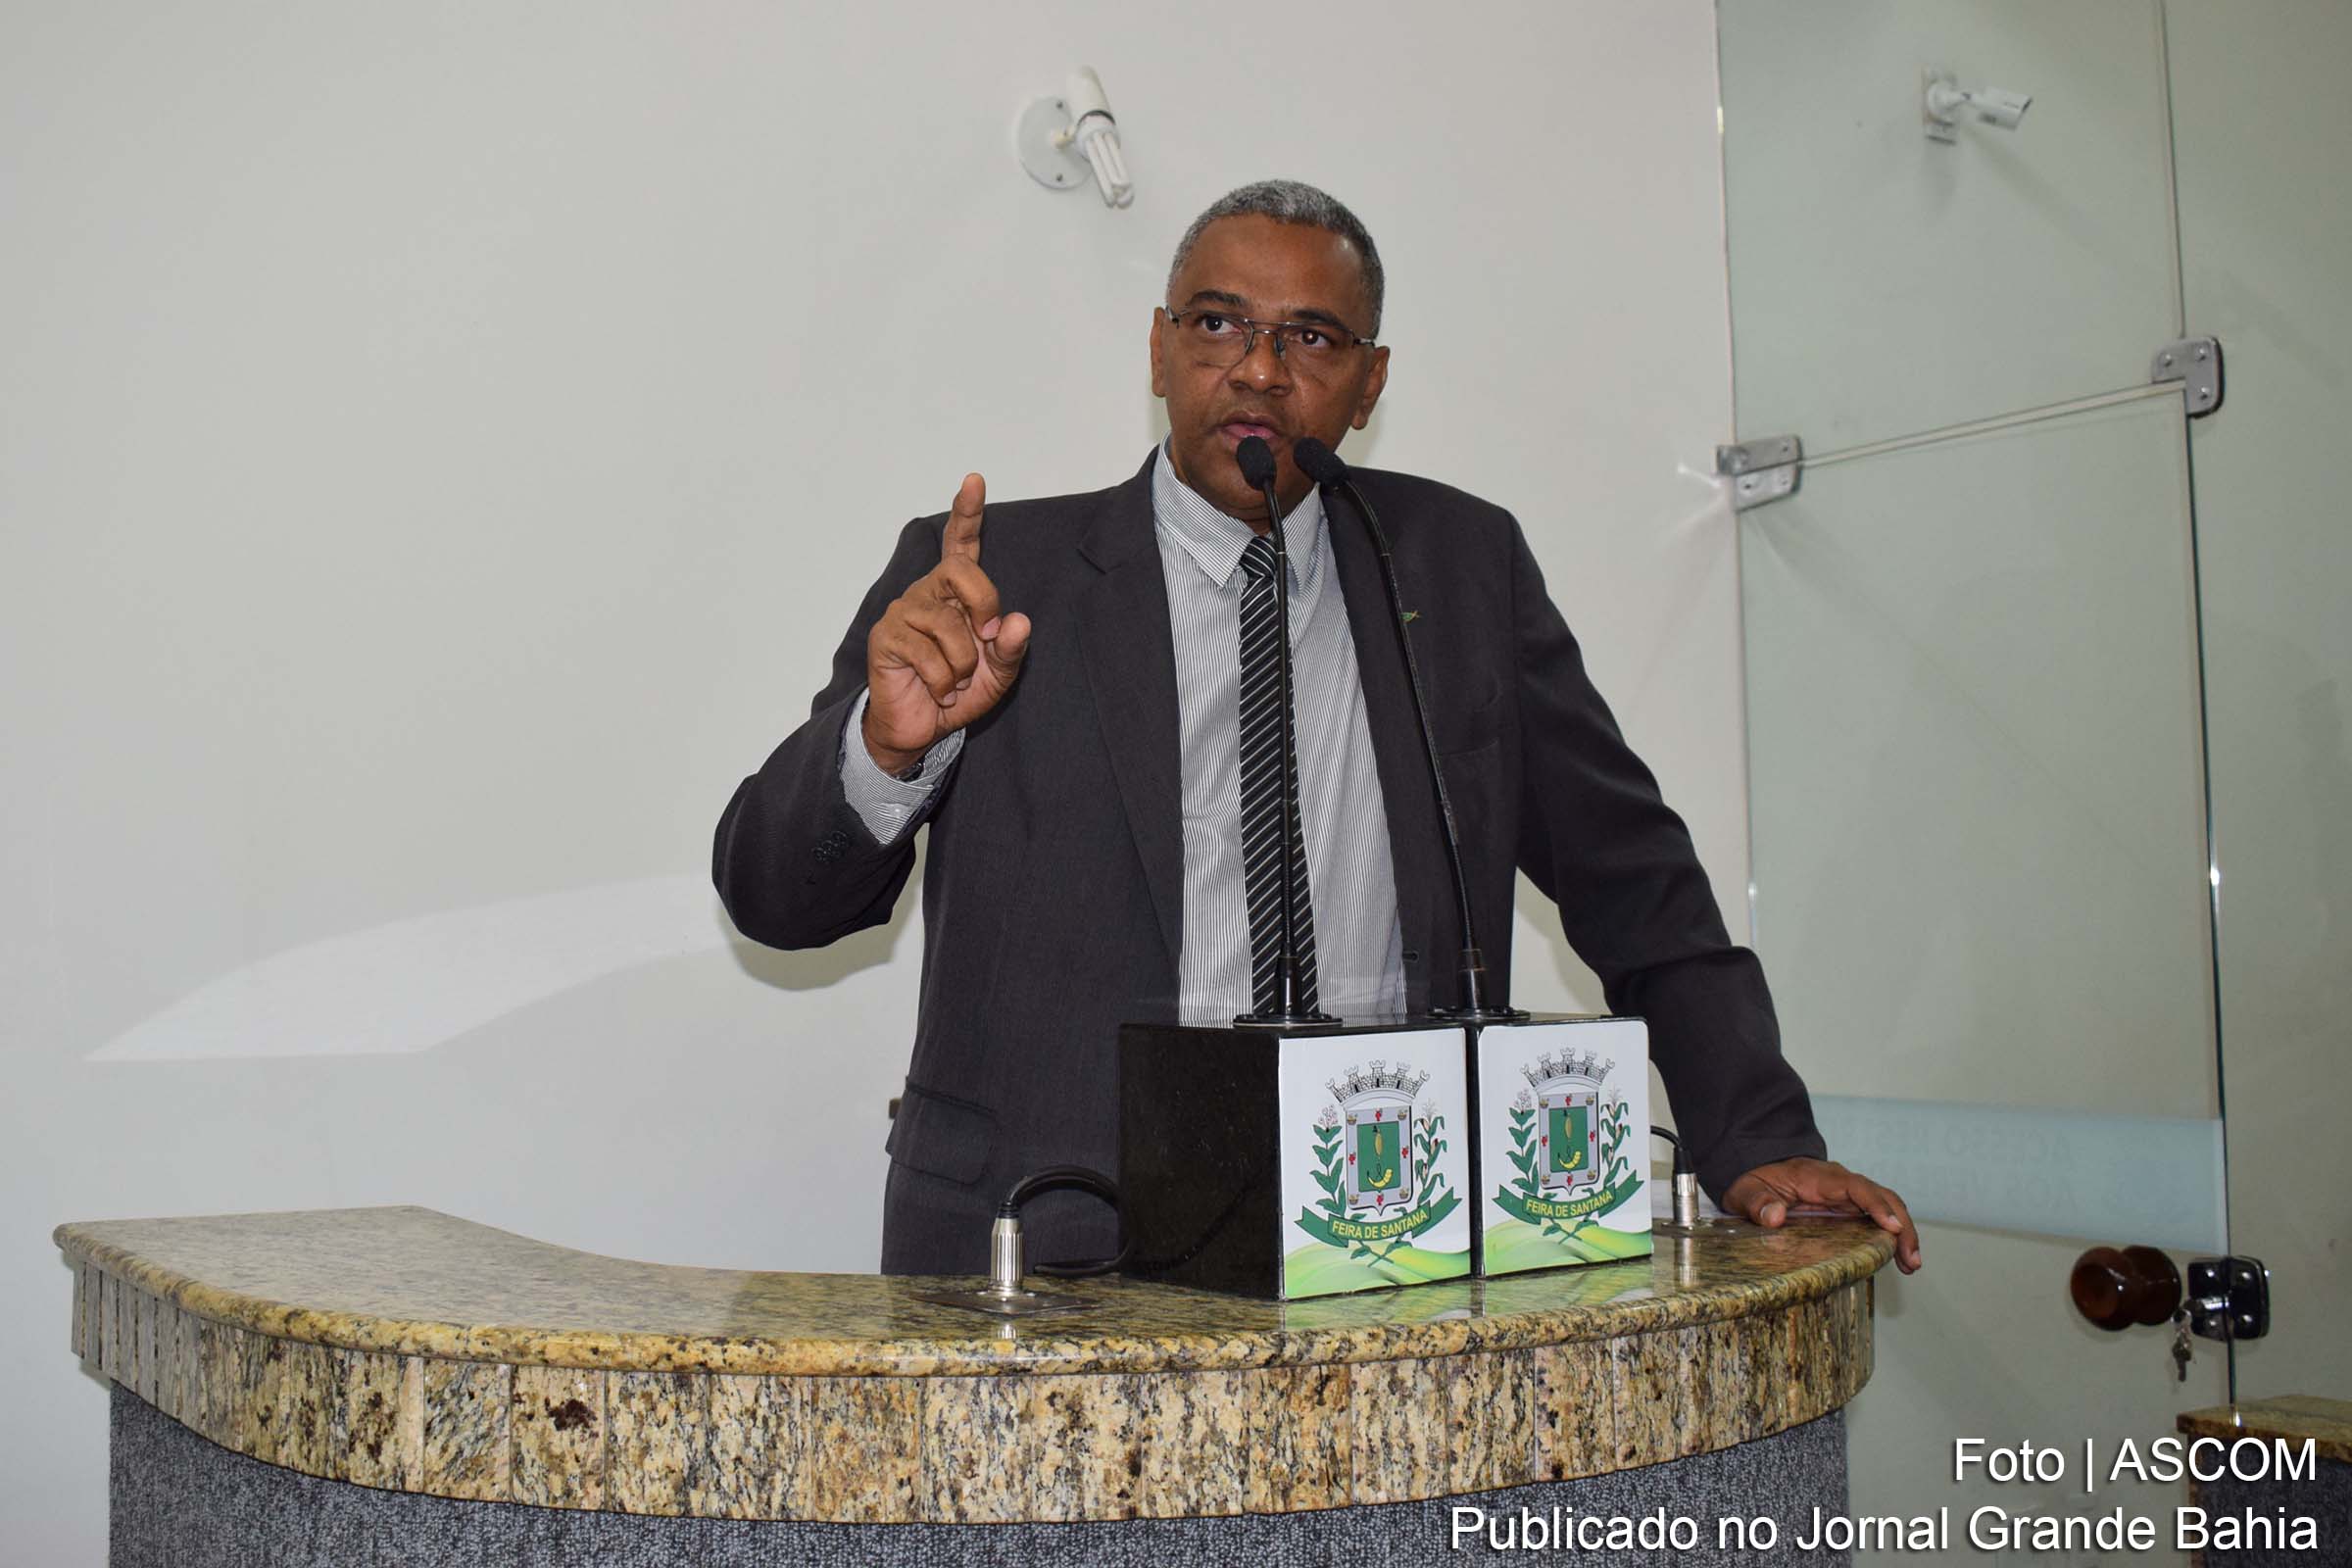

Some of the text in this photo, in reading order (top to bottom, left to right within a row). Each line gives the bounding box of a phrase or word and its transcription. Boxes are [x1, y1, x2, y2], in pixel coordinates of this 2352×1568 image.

[1527, 1189, 1613, 1218] FEIRA DE SANTANA
[1333, 1209, 1428, 1239] FEIRA DE SANTANA
